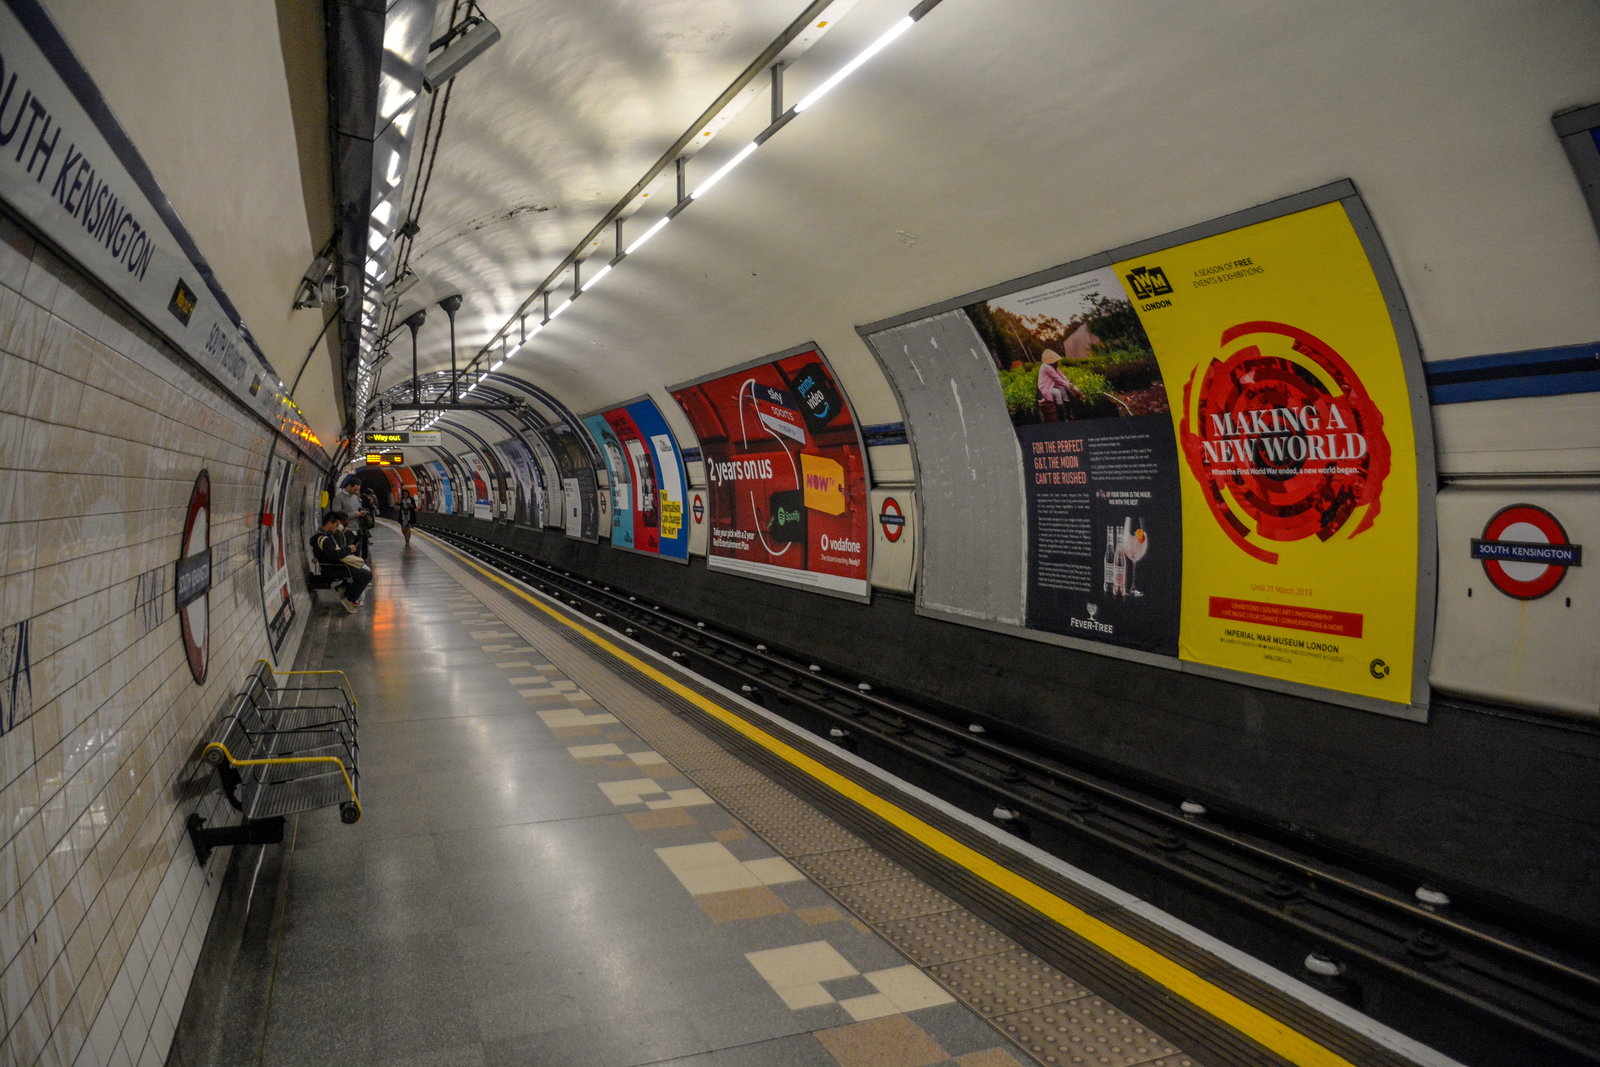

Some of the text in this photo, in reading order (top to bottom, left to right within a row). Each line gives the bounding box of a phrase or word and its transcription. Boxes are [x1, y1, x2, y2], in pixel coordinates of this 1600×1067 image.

[0, 54, 156, 282] UTH KENSINGTON
[1199, 265, 1224, 277] SEASON
[1224, 263, 1233, 271] OF
[1233, 258, 1253, 268] FREE
[1193, 266, 1264, 289] EVENTS & EXHIBITIONS
[1141, 299, 1172, 312] LONDON
[798, 375, 815, 399] prime
[767, 388, 783, 405] sky
[806, 390, 825, 410] video
[771, 406, 794, 421] sports
[1210, 403, 1347, 437] MAKING A
[373, 434, 388, 442] Way
[1032, 439, 1083, 454] FOR THE PERFECT
[1202, 433, 1367, 463] NEW WORLD
[1048, 456, 1060, 468] THE
[1060, 455, 1079, 468] MOON
[707, 457, 773, 487] 2 years on us
[1053, 472, 1061, 484] BE
[1061, 471, 1087, 484] RUSHED
[1317, 466, 1336, 474] world
[1336, 467, 1359, 475] began.
[806, 474, 828, 491] NOW
[785, 510, 801, 522] Spotify
[829, 537, 861, 553] vodafone
[1479, 544, 1572, 559] SOUTH KENSINGTON
[1276, 586, 1294, 595] March
[1296, 587, 1313, 596] 2019
[1070, 617, 1113, 634] FEVER-TREE
[1224, 628, 1339, 653] IMPERIAL WAR MUSEUM LONDON
